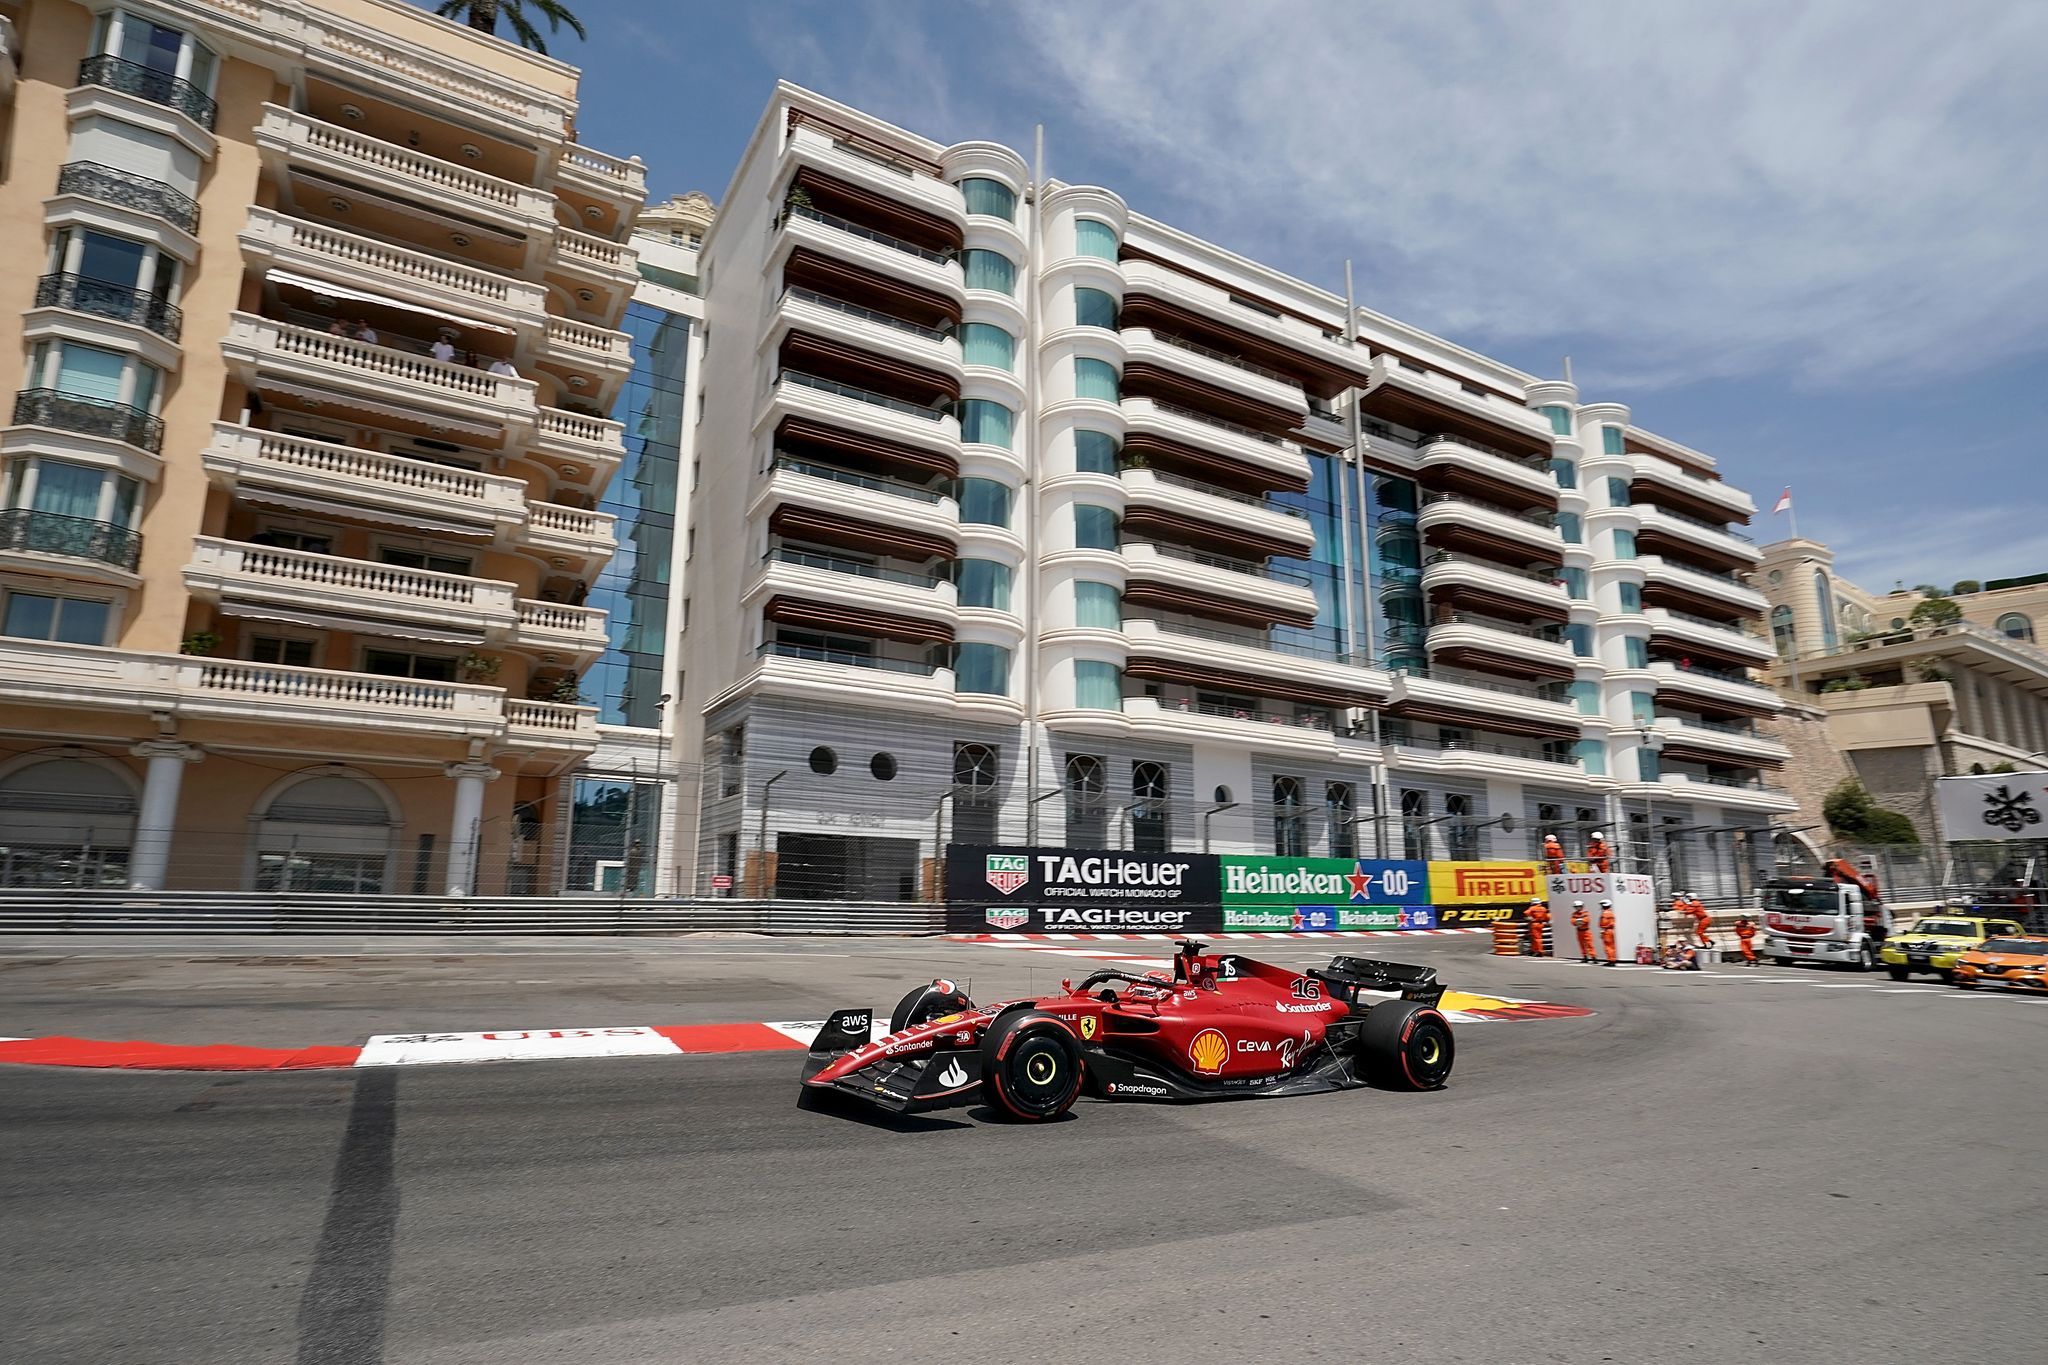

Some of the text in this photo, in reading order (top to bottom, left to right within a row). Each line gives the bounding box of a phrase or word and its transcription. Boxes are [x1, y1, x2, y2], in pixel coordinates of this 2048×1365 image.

[990, 857, 1025, 870] TAG
[987, 872, 1027, 892] HEUER
[1225, 866, 1344, 894] Heineken
[1455, 868, 1536, 896] PIRELLI
[1567, 878, 1605, 893] UBS
[1627, 878, 1650, 894] UBS
[1044, 887, 1182, 898] OFFICIAL WATCH MONACO GP
[1224, 910, 1290, 926] Heineken
[1339, 910, 1396, 925] Heineken
[1441, 908, 1514, 921] P ZERO
[1290, 977, 1320, 1000] 16
[1284, 1002, 1332, 1013] Santander
[842, 1014, 868, 1027] aws
[1059, 1013, 1078, 1021] ILLE
[480, 1028, 646, 1041] UBS
[894, 1040, 934, 1053] Santander
[1117, 1083, 1167, 1096] Snapdragon
